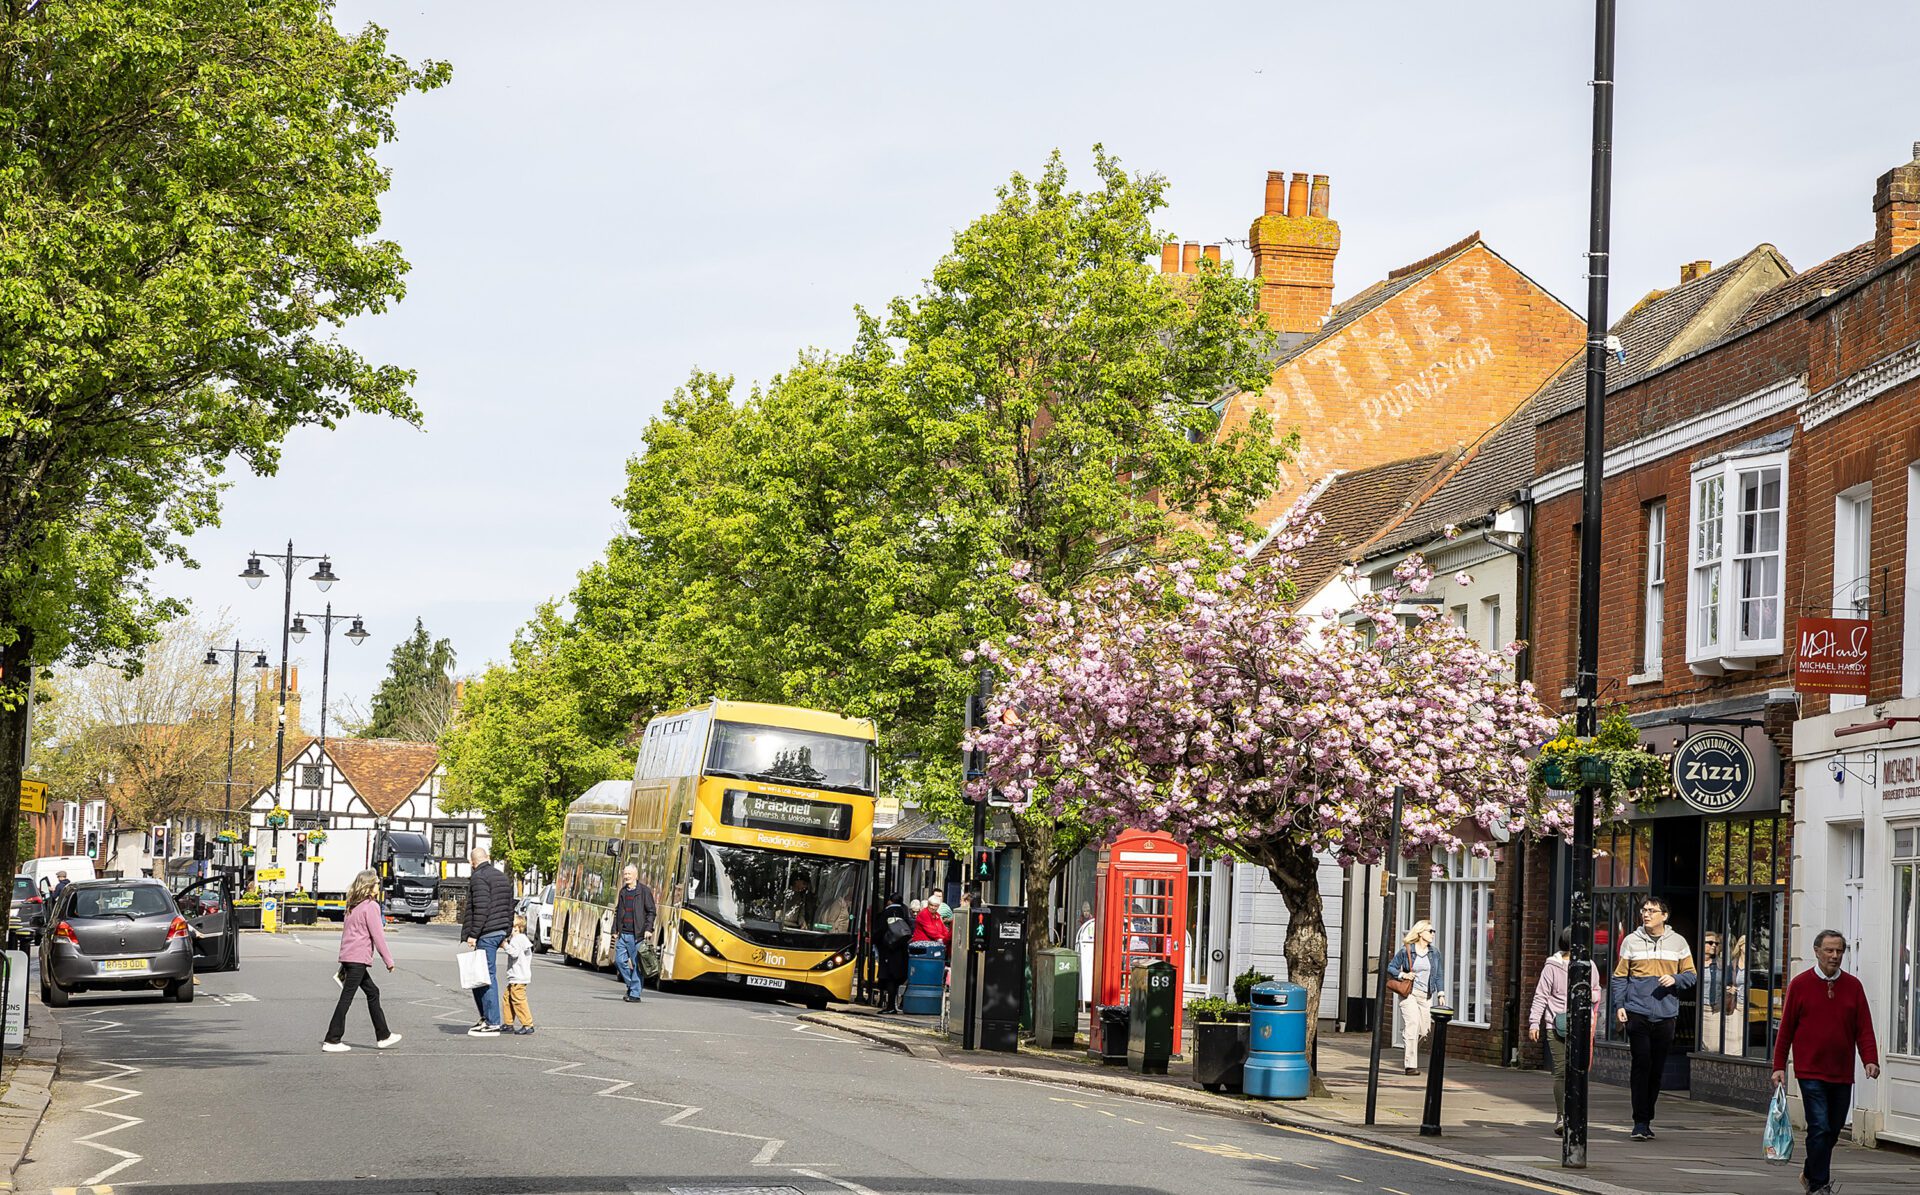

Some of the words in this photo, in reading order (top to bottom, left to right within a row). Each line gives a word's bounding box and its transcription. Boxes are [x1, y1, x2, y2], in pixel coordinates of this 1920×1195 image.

[1800, 661, 1836, 670] MICHAEL
[1838, 663, 1866, 671] HARDY
[1690, 739, 1739, 756] INDIVIDUALLY
[1685, 761, 1741, 782] Zizzi
[1883, 758, 1915, 785] MICHAEL
[1690, 788, 1736, 805] ITALIAN
[755, 798, 810, 815] Bracknell
[828, 808, 839, 827] 4
[781, 813, 786, 821] &
[788, 814, 821, 826] Wokingham
[765, 951, 785, 966] lion
[1058, 961, 1071, 971] 34
[751, 977, 768, 986] YX73
[769, 979, 783, 988] PHU
